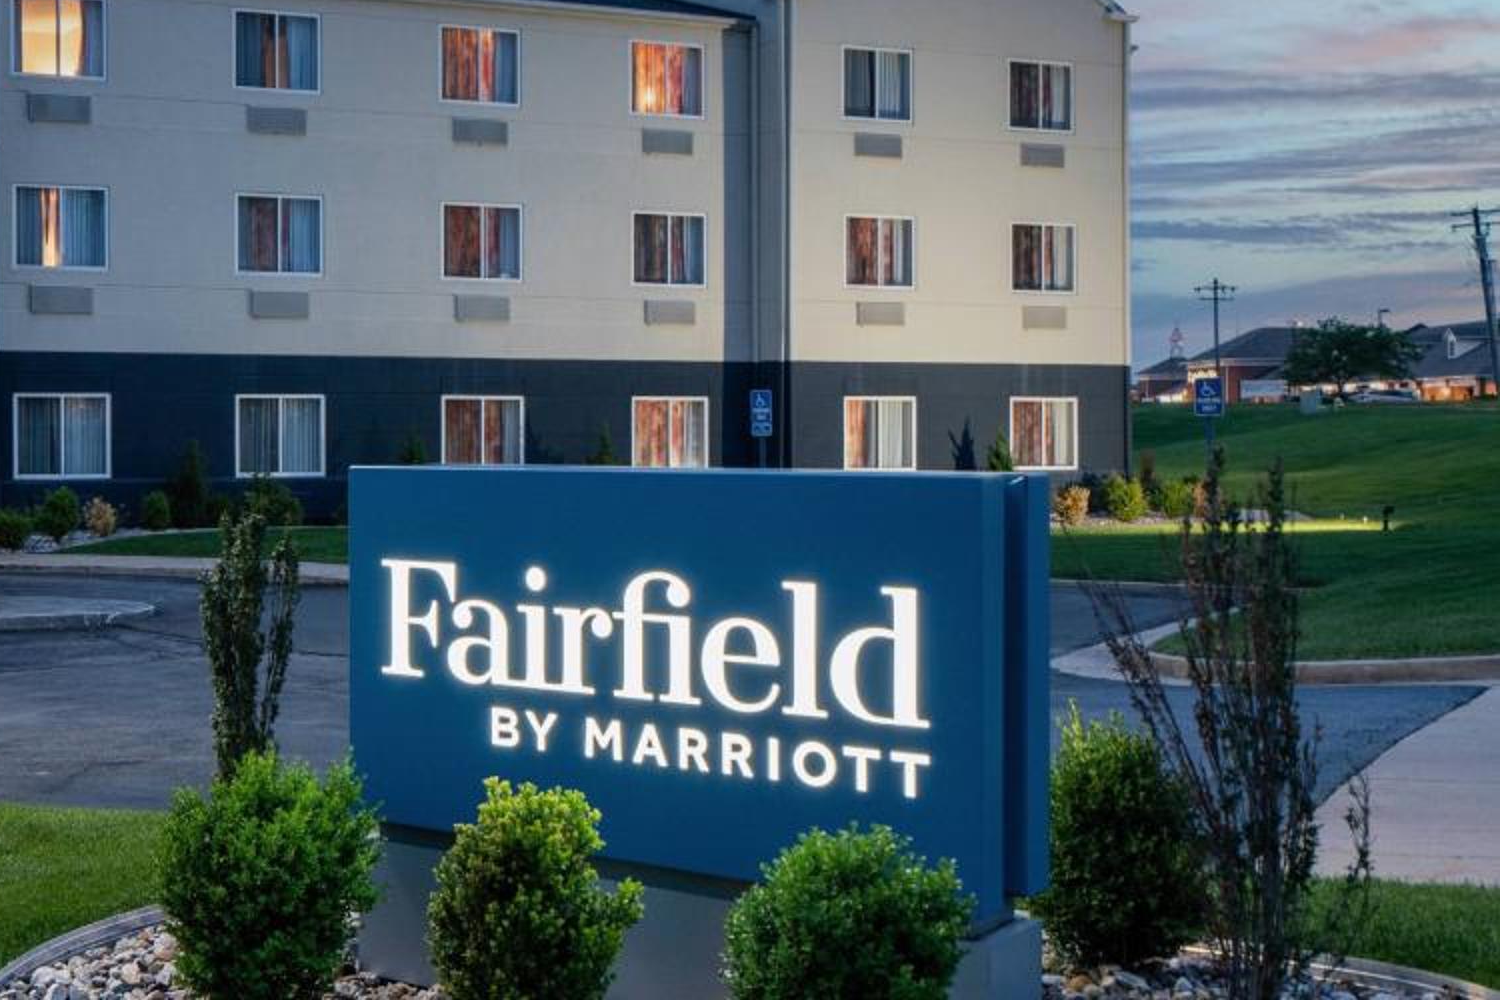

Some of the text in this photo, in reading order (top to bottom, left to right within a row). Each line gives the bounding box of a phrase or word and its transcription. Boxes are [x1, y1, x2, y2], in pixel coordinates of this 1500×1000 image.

[380, 557, 931, 729] Fairfield
[489, 706, 932, 799] BY MARRIOTT
